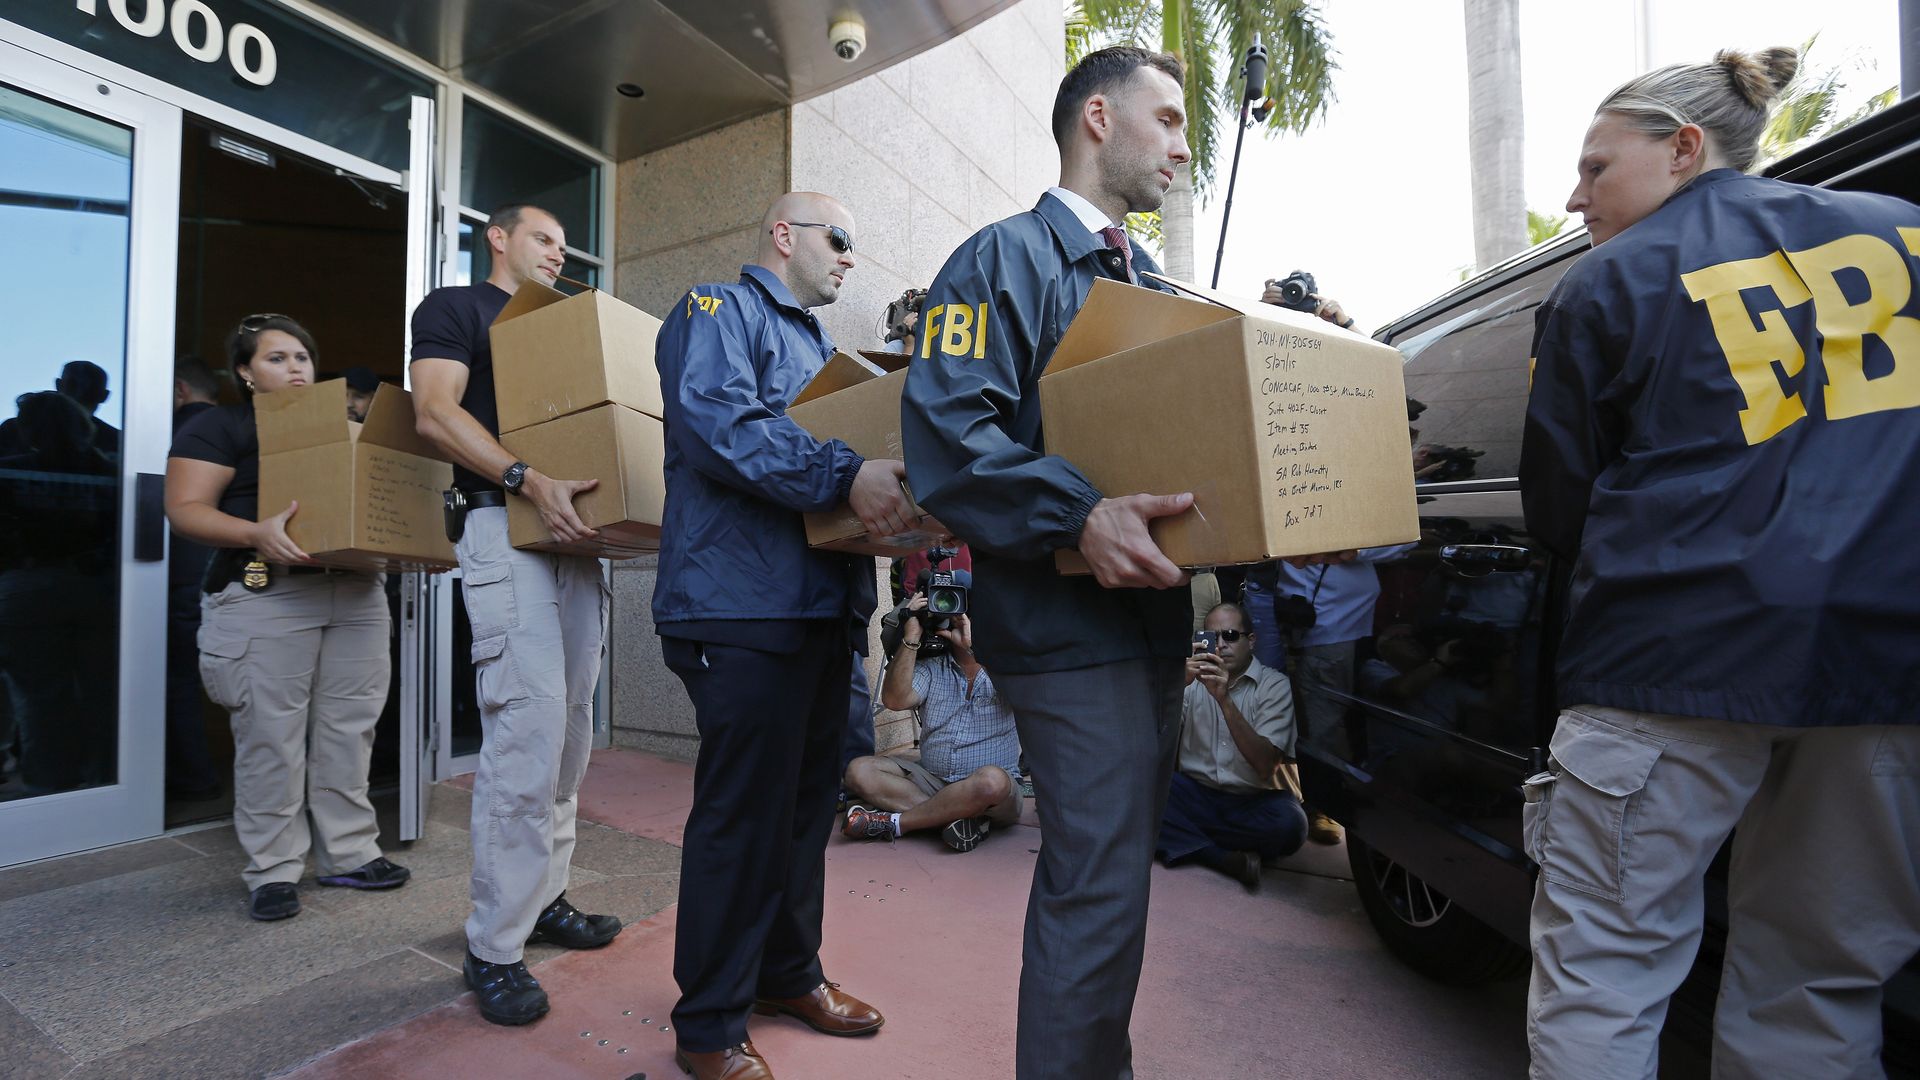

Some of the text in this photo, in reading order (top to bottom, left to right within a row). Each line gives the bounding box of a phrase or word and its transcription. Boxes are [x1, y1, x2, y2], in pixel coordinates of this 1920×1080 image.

[77, 0, 277, 86] 000
[921, 302, 988, 359] FBI
[1680, 227, 1920, 446] FB
[1264, 352, 1297, 372] 5/27/15
[1307, 384, 1320, 394] 1000
[1267, 400, 1285, 416] Suite
[1266, 420, 1310, 437] Item # 35
[1272, 443, 1298, 459] Meeting
[1291, 463, 1302, 478] Rob
[1285, 510, 1300, 528] Box
[1303, 506, 1310, 519] 7
[1317, 504, 1323, 518] 7
